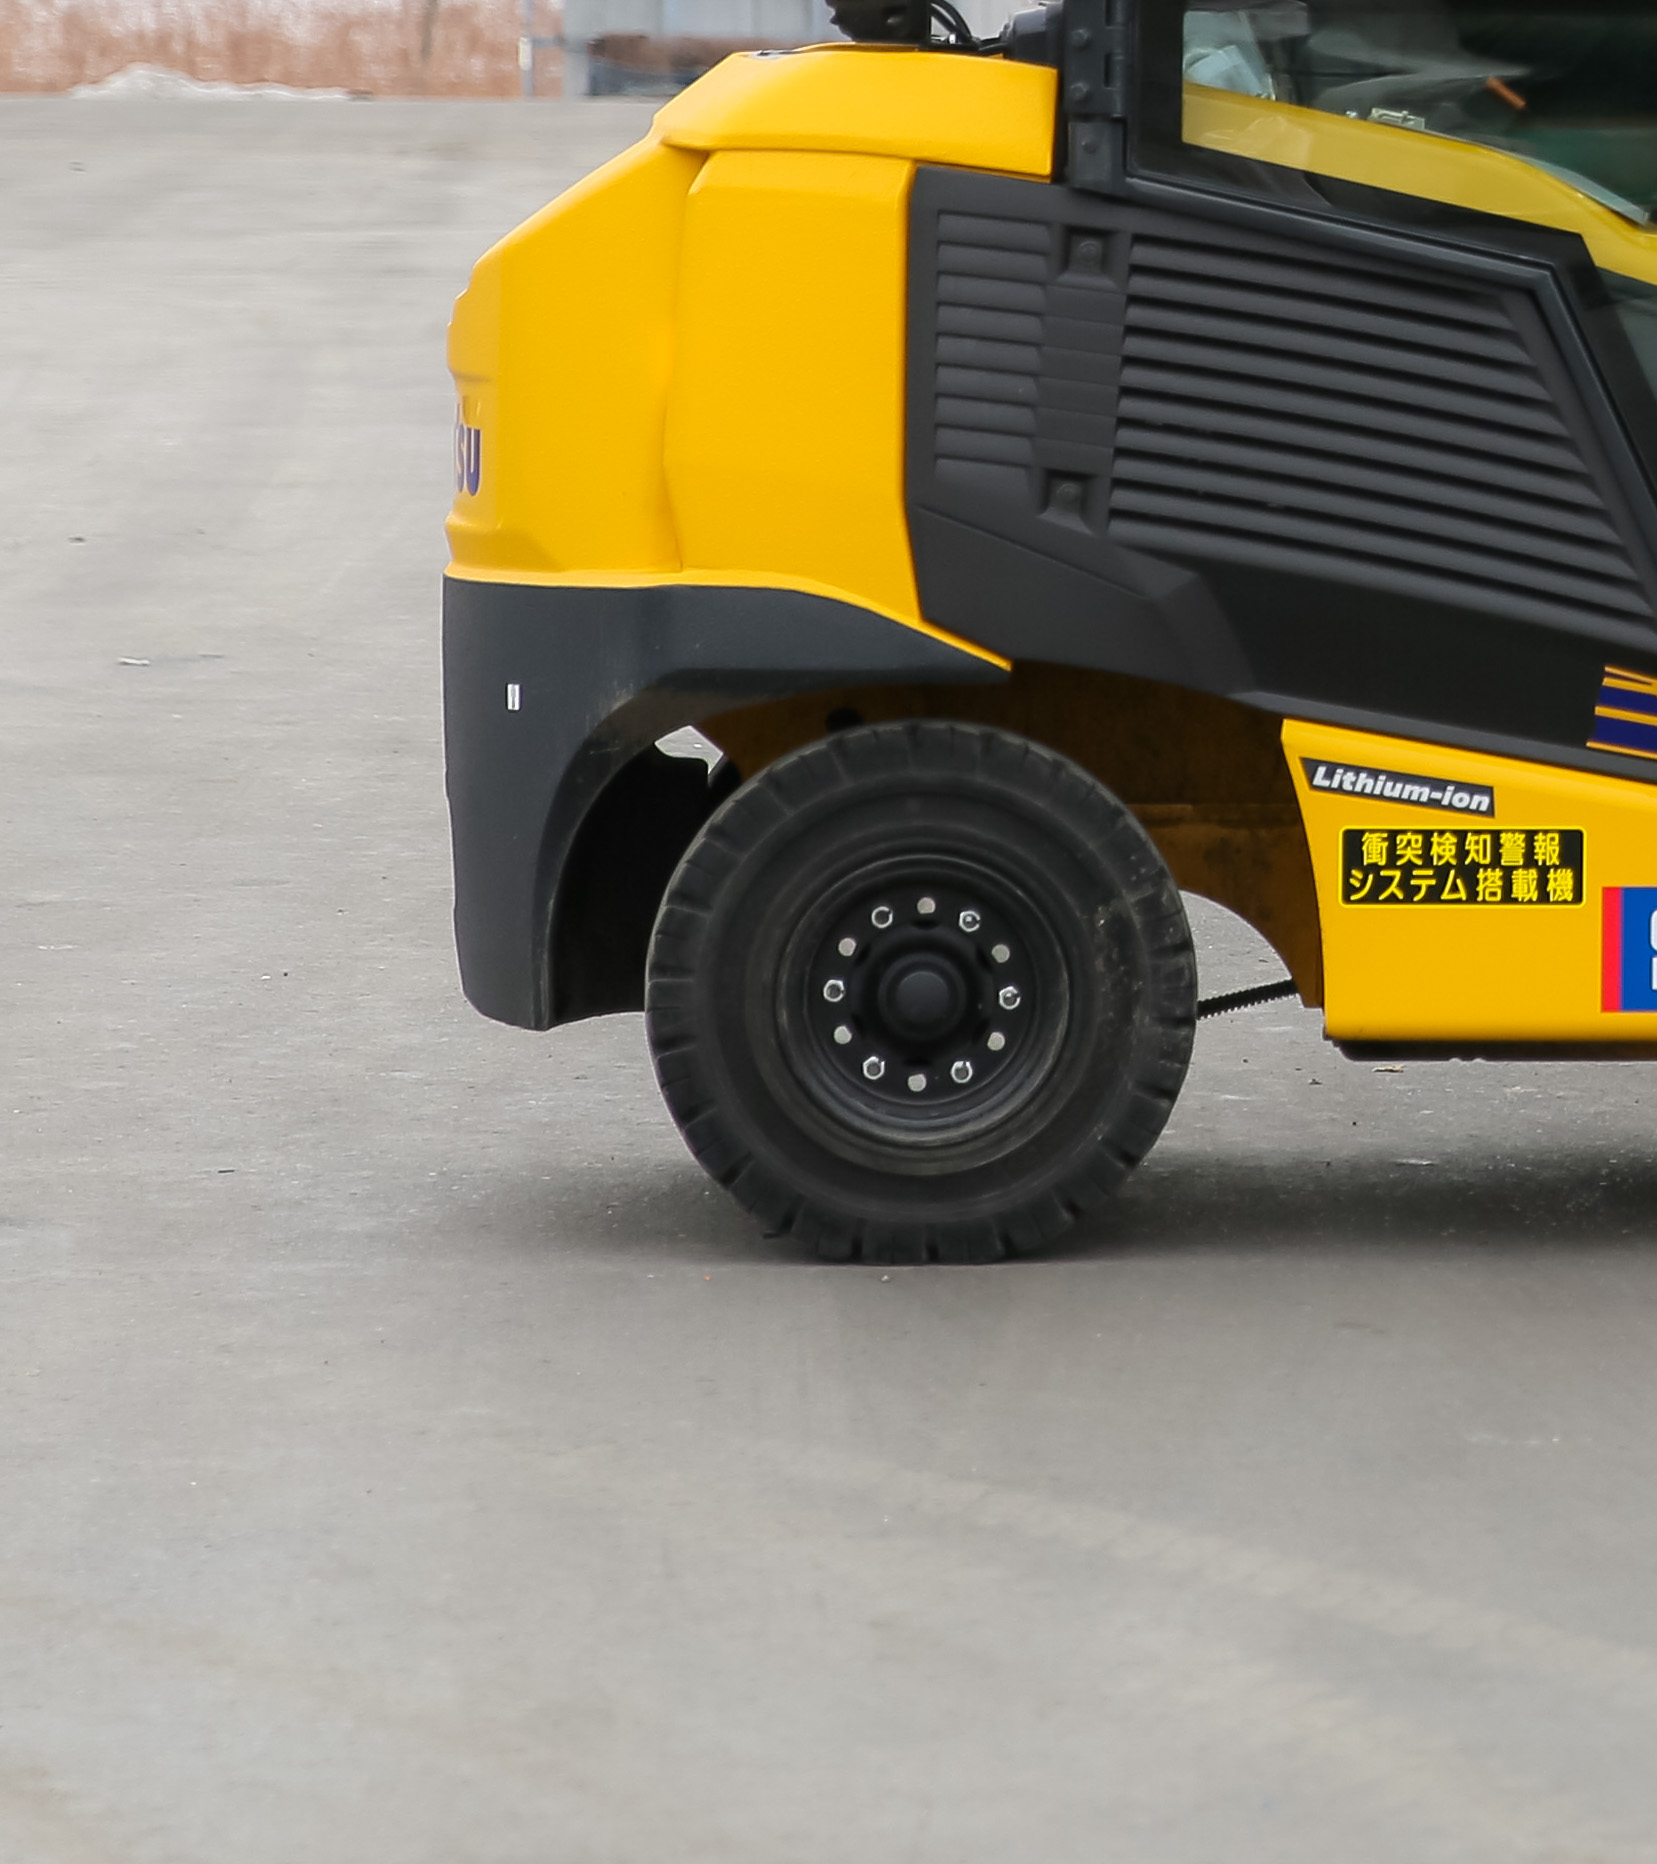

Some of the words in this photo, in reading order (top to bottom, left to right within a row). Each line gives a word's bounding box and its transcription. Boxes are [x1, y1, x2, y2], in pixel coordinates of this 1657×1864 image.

[1312, 765, 1490, 812] Lithium-ion
[1361, 831, 1561, 867] 衝突検知警報
[1348, 868, 1575, 903] システム搭載機
